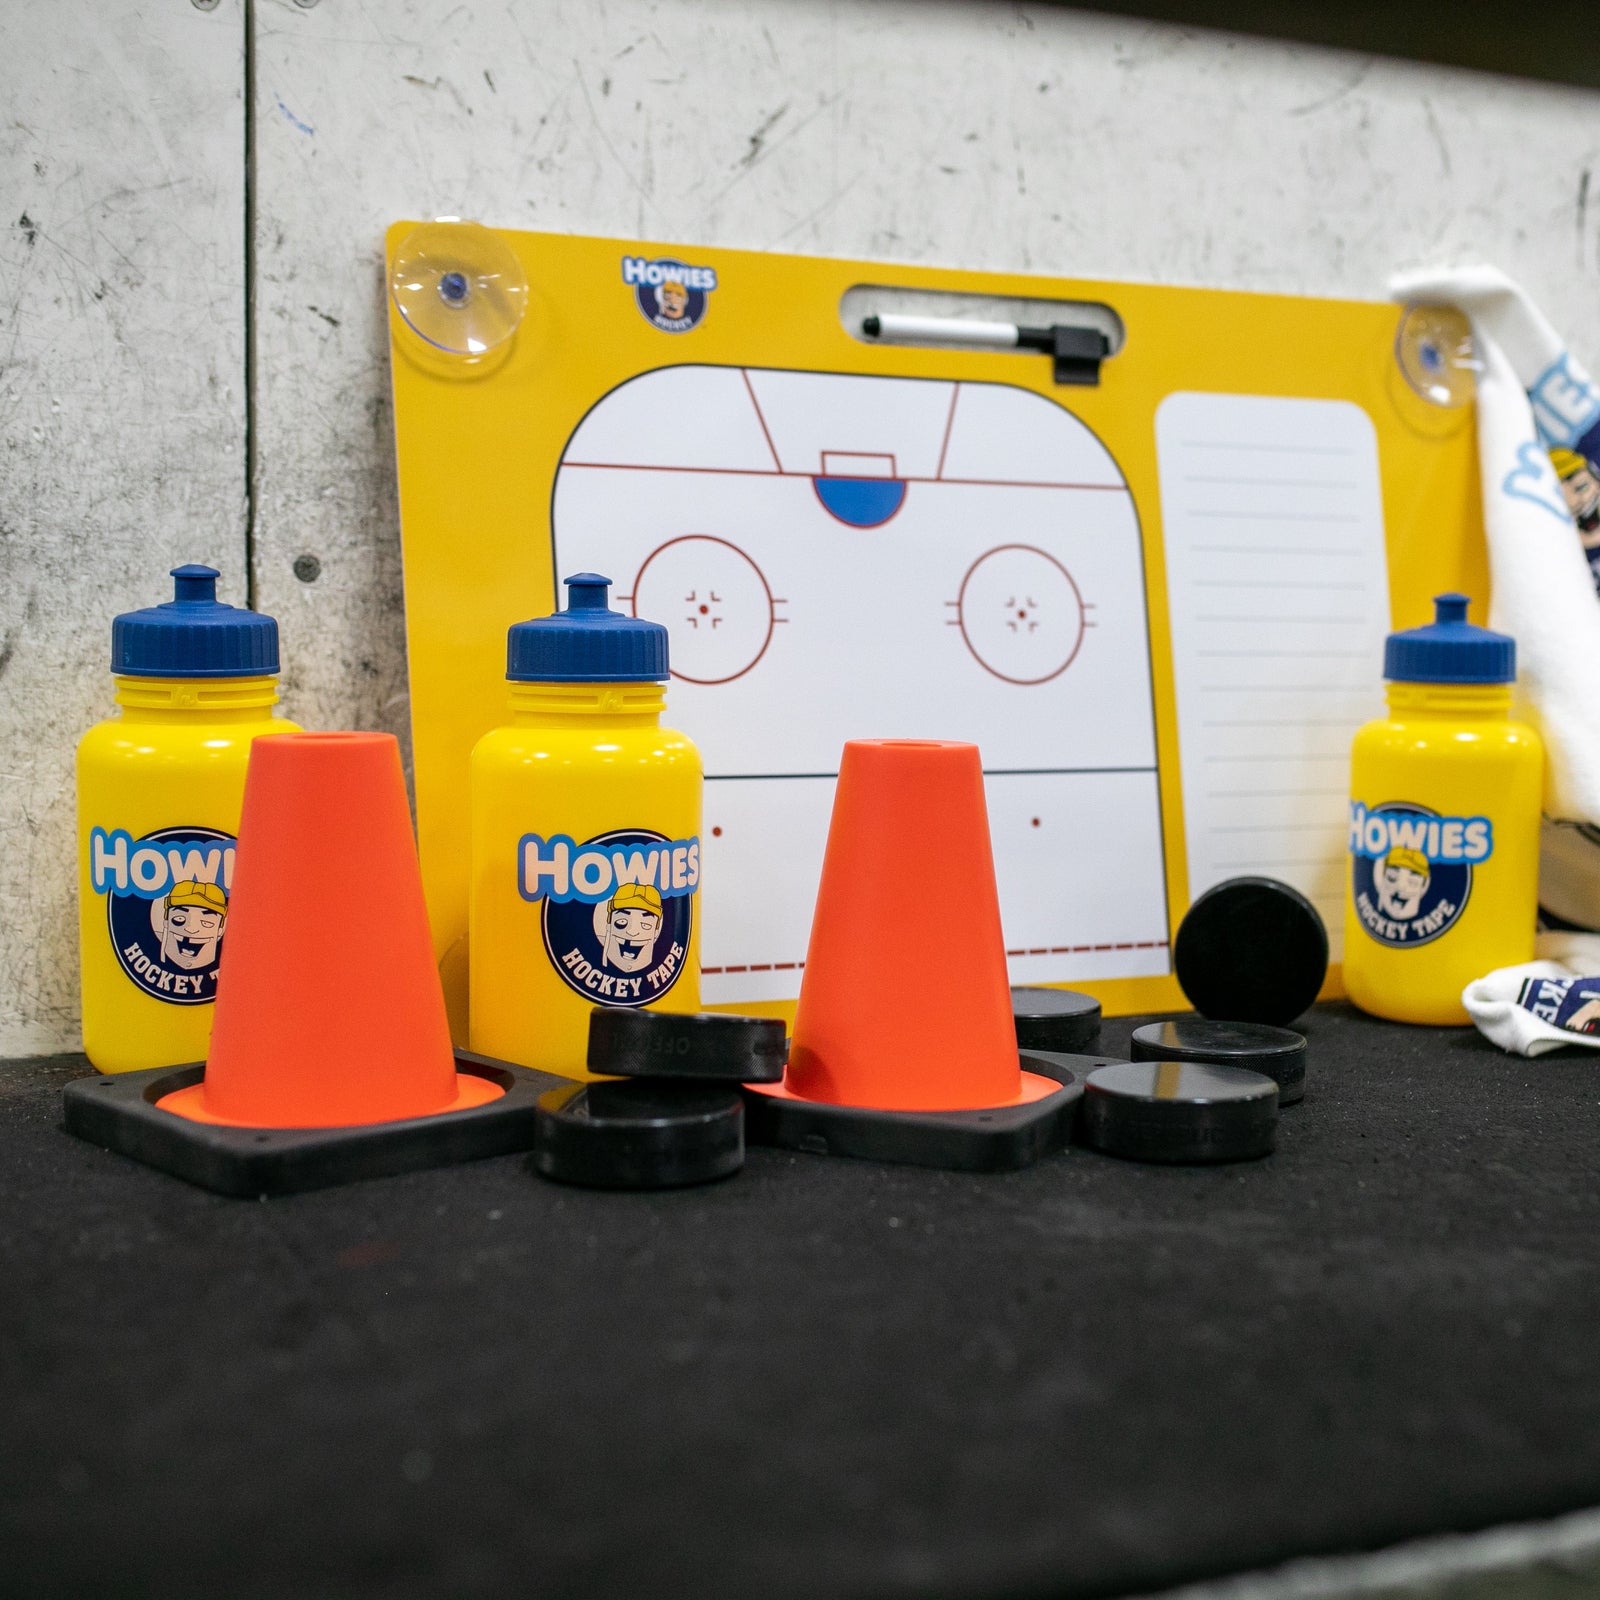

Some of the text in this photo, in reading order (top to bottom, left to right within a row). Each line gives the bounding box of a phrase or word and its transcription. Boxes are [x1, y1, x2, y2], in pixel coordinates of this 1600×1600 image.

[623, 257, 716, 289] HOWIES
[1350, 807, 1489, 858] HOWIES
[525, 841, 700, 895] HOWIES
[1357, 892, 1456, 941] HOCKEY TAPE
[124, 942, 204, 994] HOCKEY
[561, 942, 684, 998] HOCKEY TAPE
